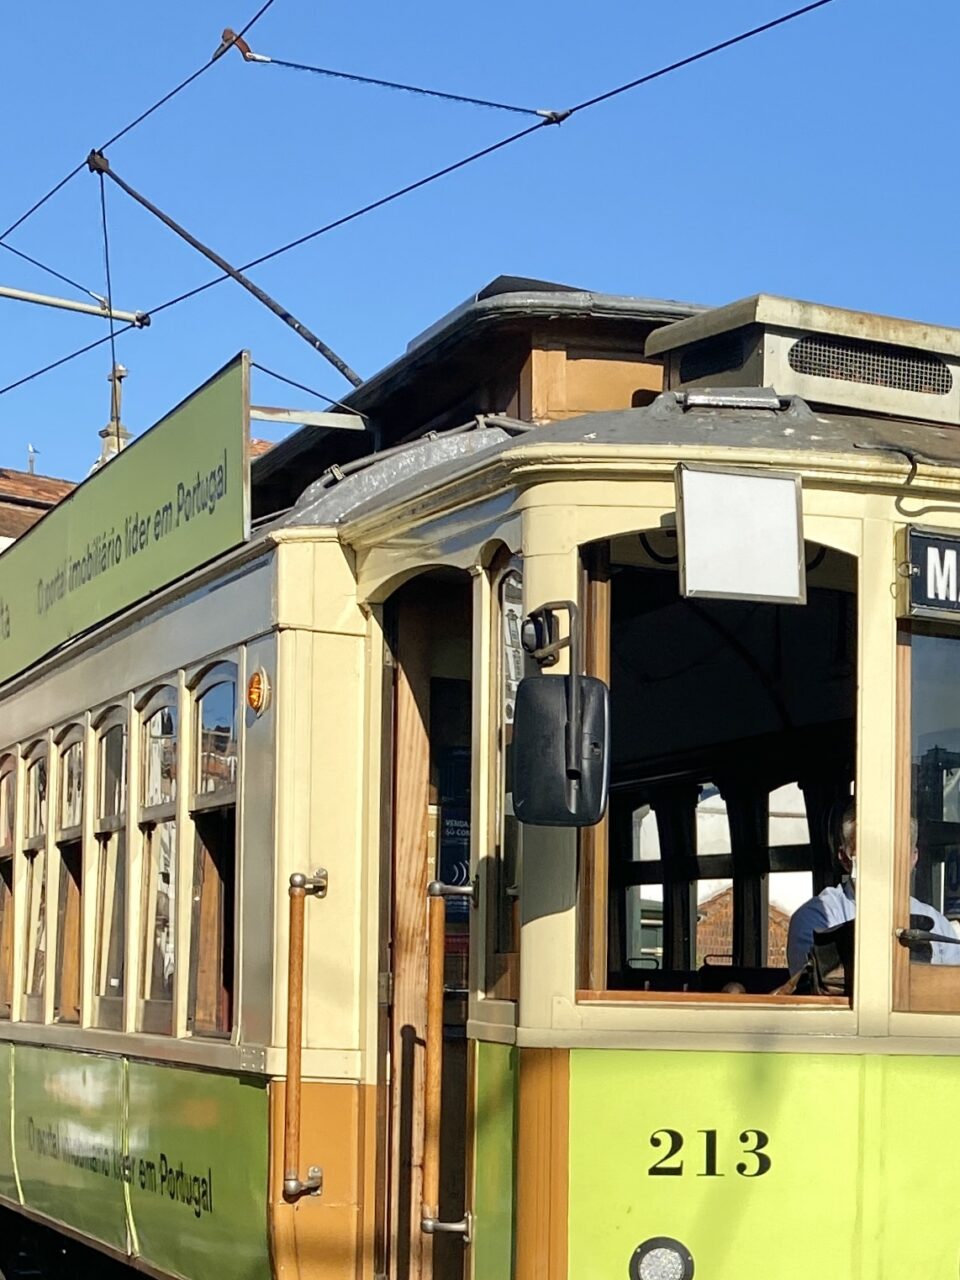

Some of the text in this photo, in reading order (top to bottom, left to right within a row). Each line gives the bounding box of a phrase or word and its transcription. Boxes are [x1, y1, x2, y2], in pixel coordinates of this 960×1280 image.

[154, 501, 173, 542] em
[176, 448, 228, 528] Portugal
[139, 1158, 157, 1193] em
[159, 1152, 213, 1219] Portugal
[648, 1128, 773, 1178] 213
